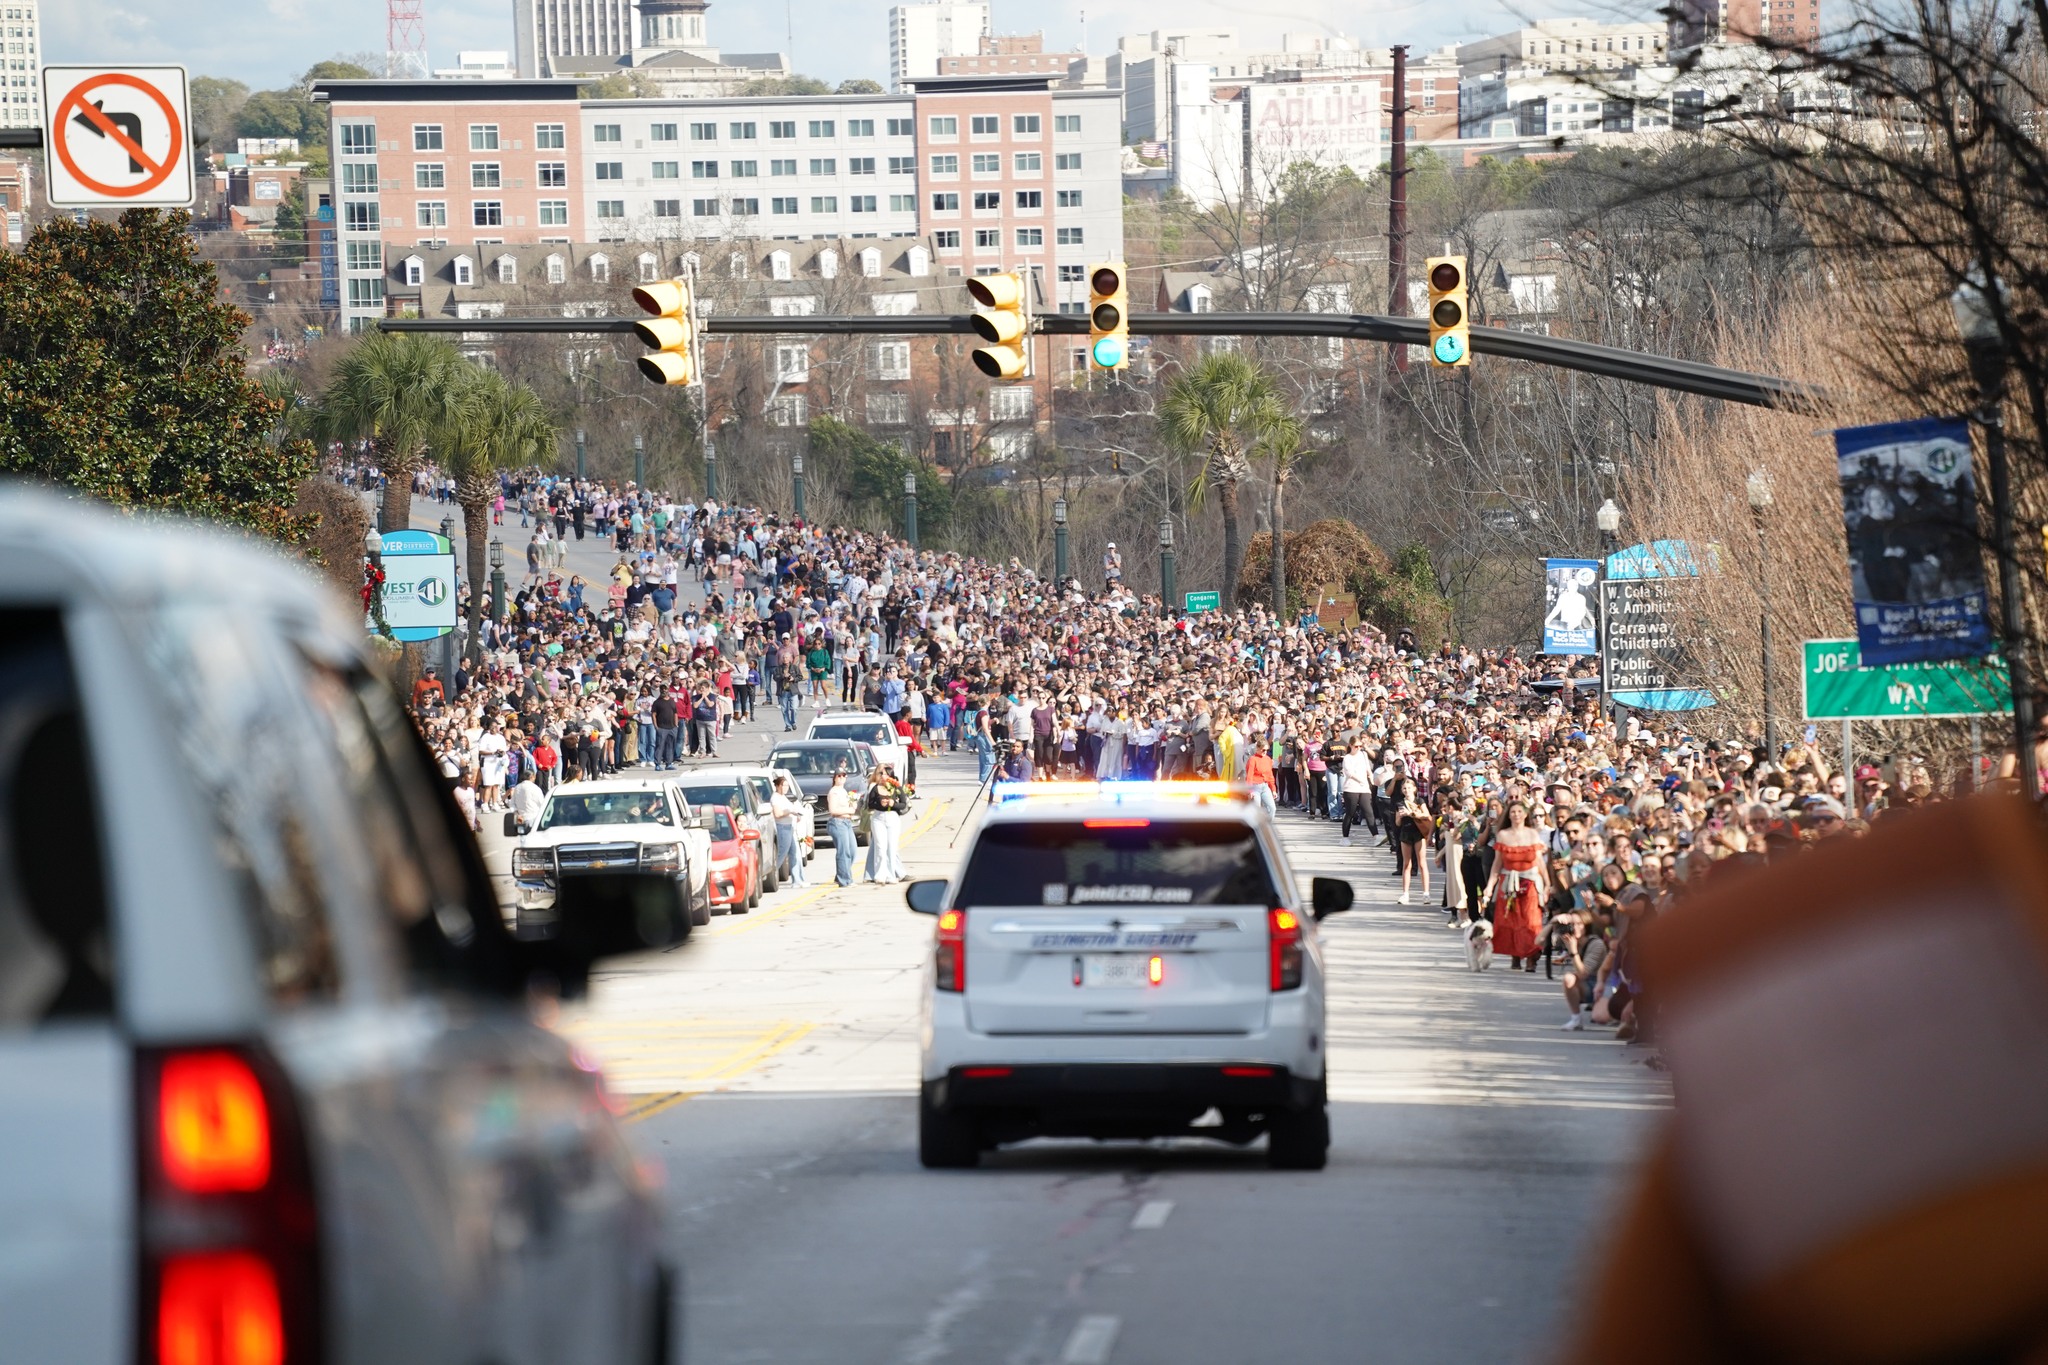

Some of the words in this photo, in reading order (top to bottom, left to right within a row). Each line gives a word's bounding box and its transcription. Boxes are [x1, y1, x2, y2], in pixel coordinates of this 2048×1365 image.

[1258, 95, 1367, 127] ADLUH
[1339, 127, 1375, 144] FEED
[322, 233, 333, 297] HOMEWOOD
[382, 542, 402, 551] VER
[1607, 586, 1620, 599] W.
[1625, 585, 1651, 599] Cola
[1609, 602, 1620, 614] &
[1609, 621, 1677, 640] Carraway
[1610, 657, 1654, 671] Public
[1813, 653, 1849, 673] JOE
[1611, 672, 1665, 688] Parking
[1887, 684, 1931, 705] WAY
